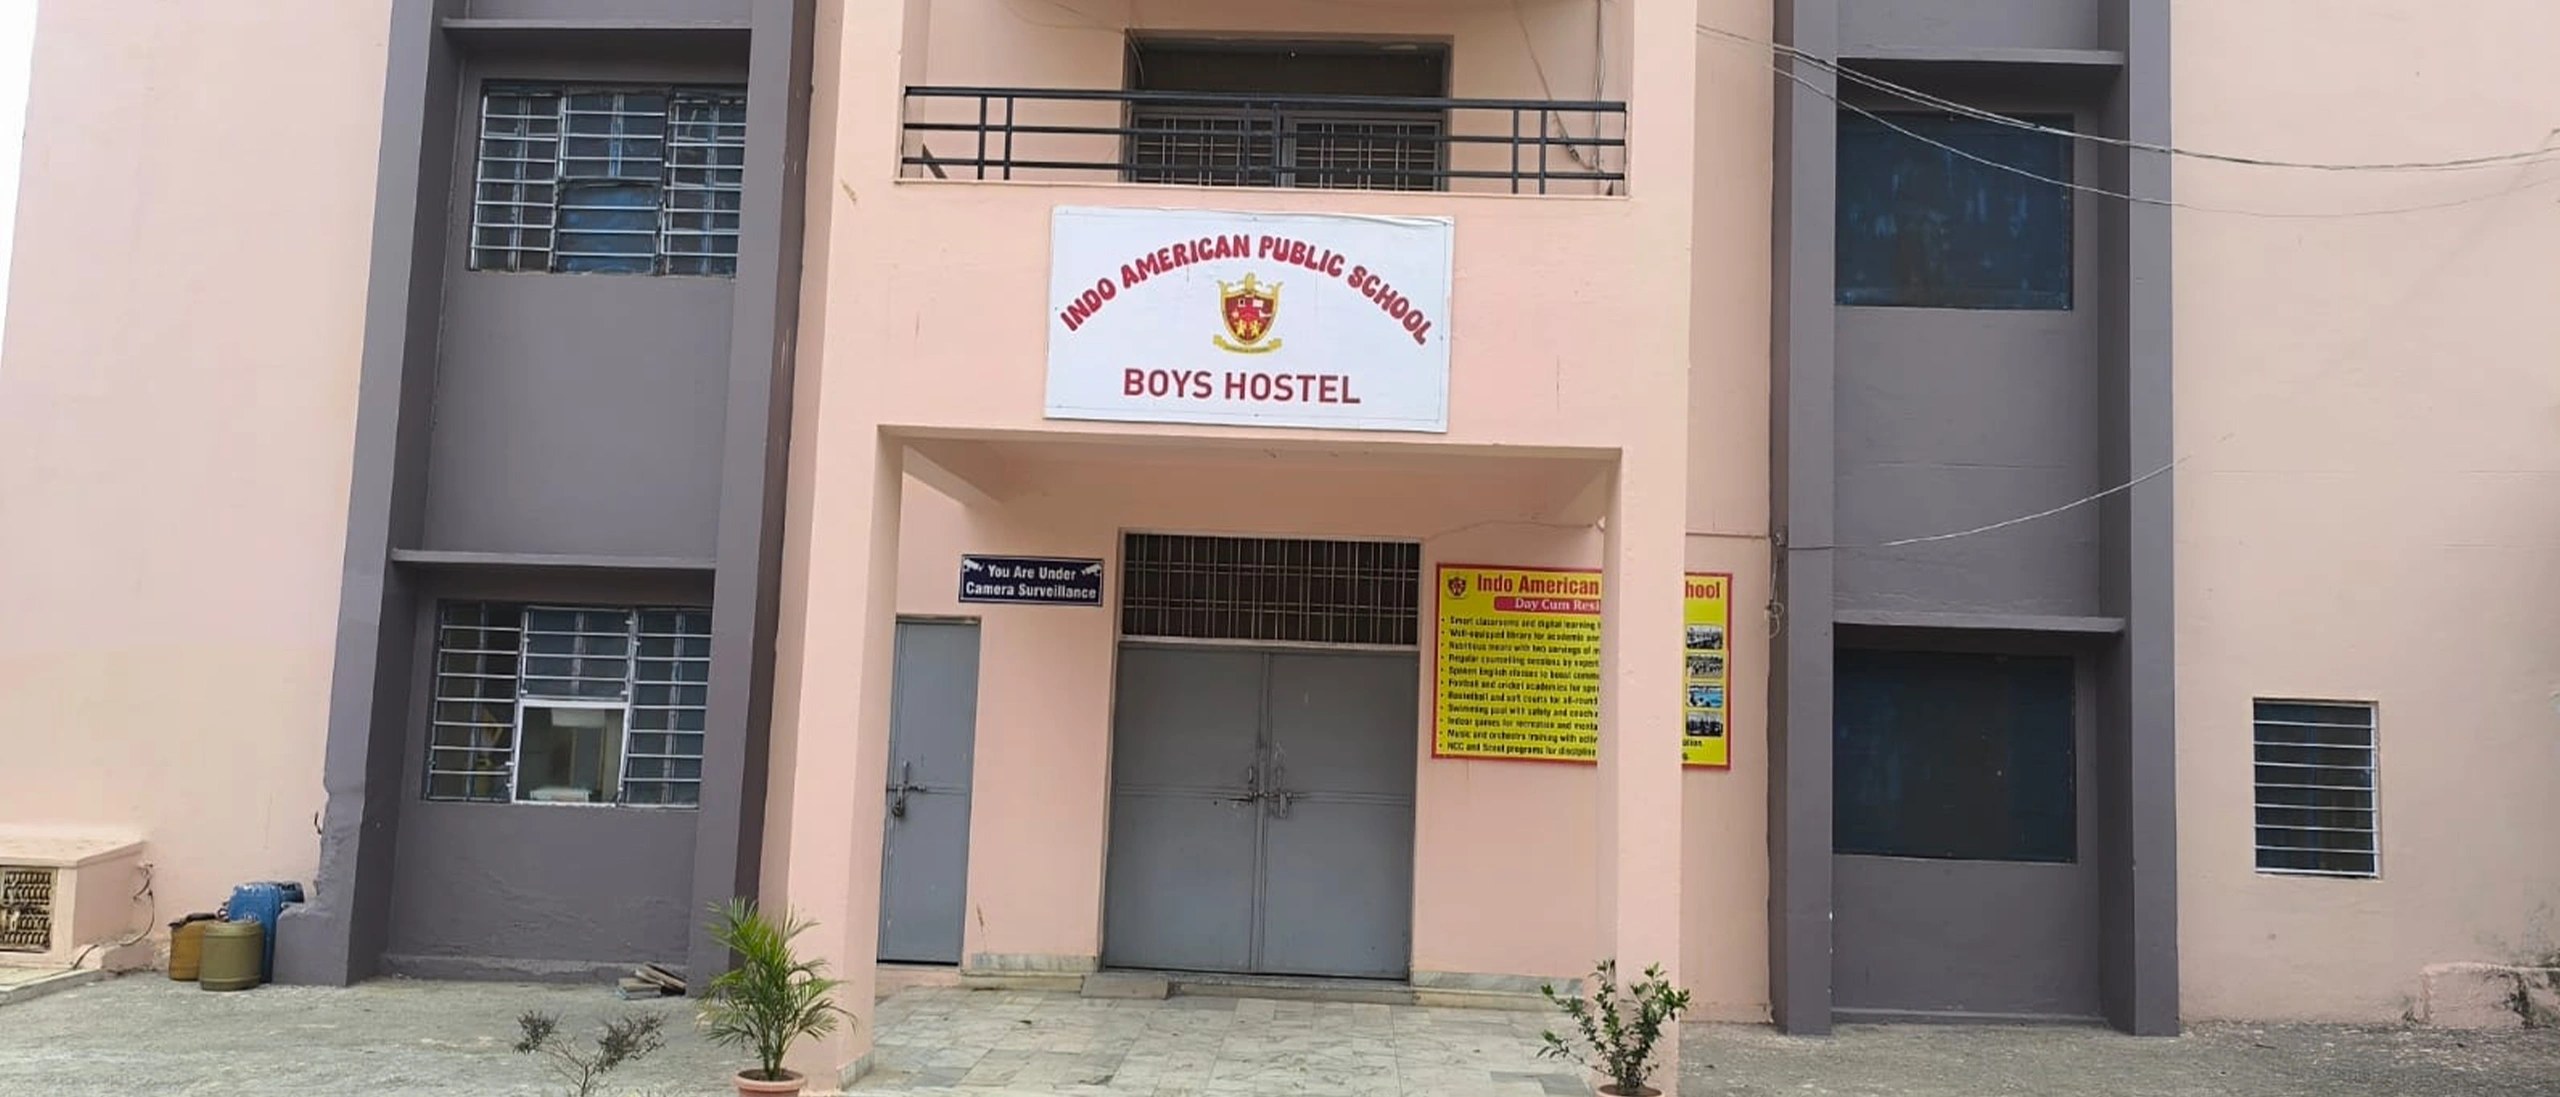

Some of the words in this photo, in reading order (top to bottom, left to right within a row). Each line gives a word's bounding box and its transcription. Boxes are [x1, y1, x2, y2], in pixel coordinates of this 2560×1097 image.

[1060, 277, 1117, 332] INDO
[1120, 234, 1250, 289] AMERICAN
[1258, 235, 1346, 277] PUBLIC
[1347, 266, 1433, 346] SCHOOL
[1123, 368, 1213, 399] BOYS
[1225, 372, 1361, 404] HOSTEL
[988, 565, 1010, 578] You
[1013, 566, 1035, 579] Are
[1039, 567, 1076, 580] Under
[966, 582, 1014, 595] Camera
[1018, 584, 1096, 599] Surveillance
[1477, 574, 1512, 591] Indo
[1519, 575, 1599, 595] American
[1685, 580, 1720, 599] hool
[1515, 598, 1538, 611] Day
[1542, 599, 1569, 610] Cum
[1574, 600, 1599, 611] Resi
